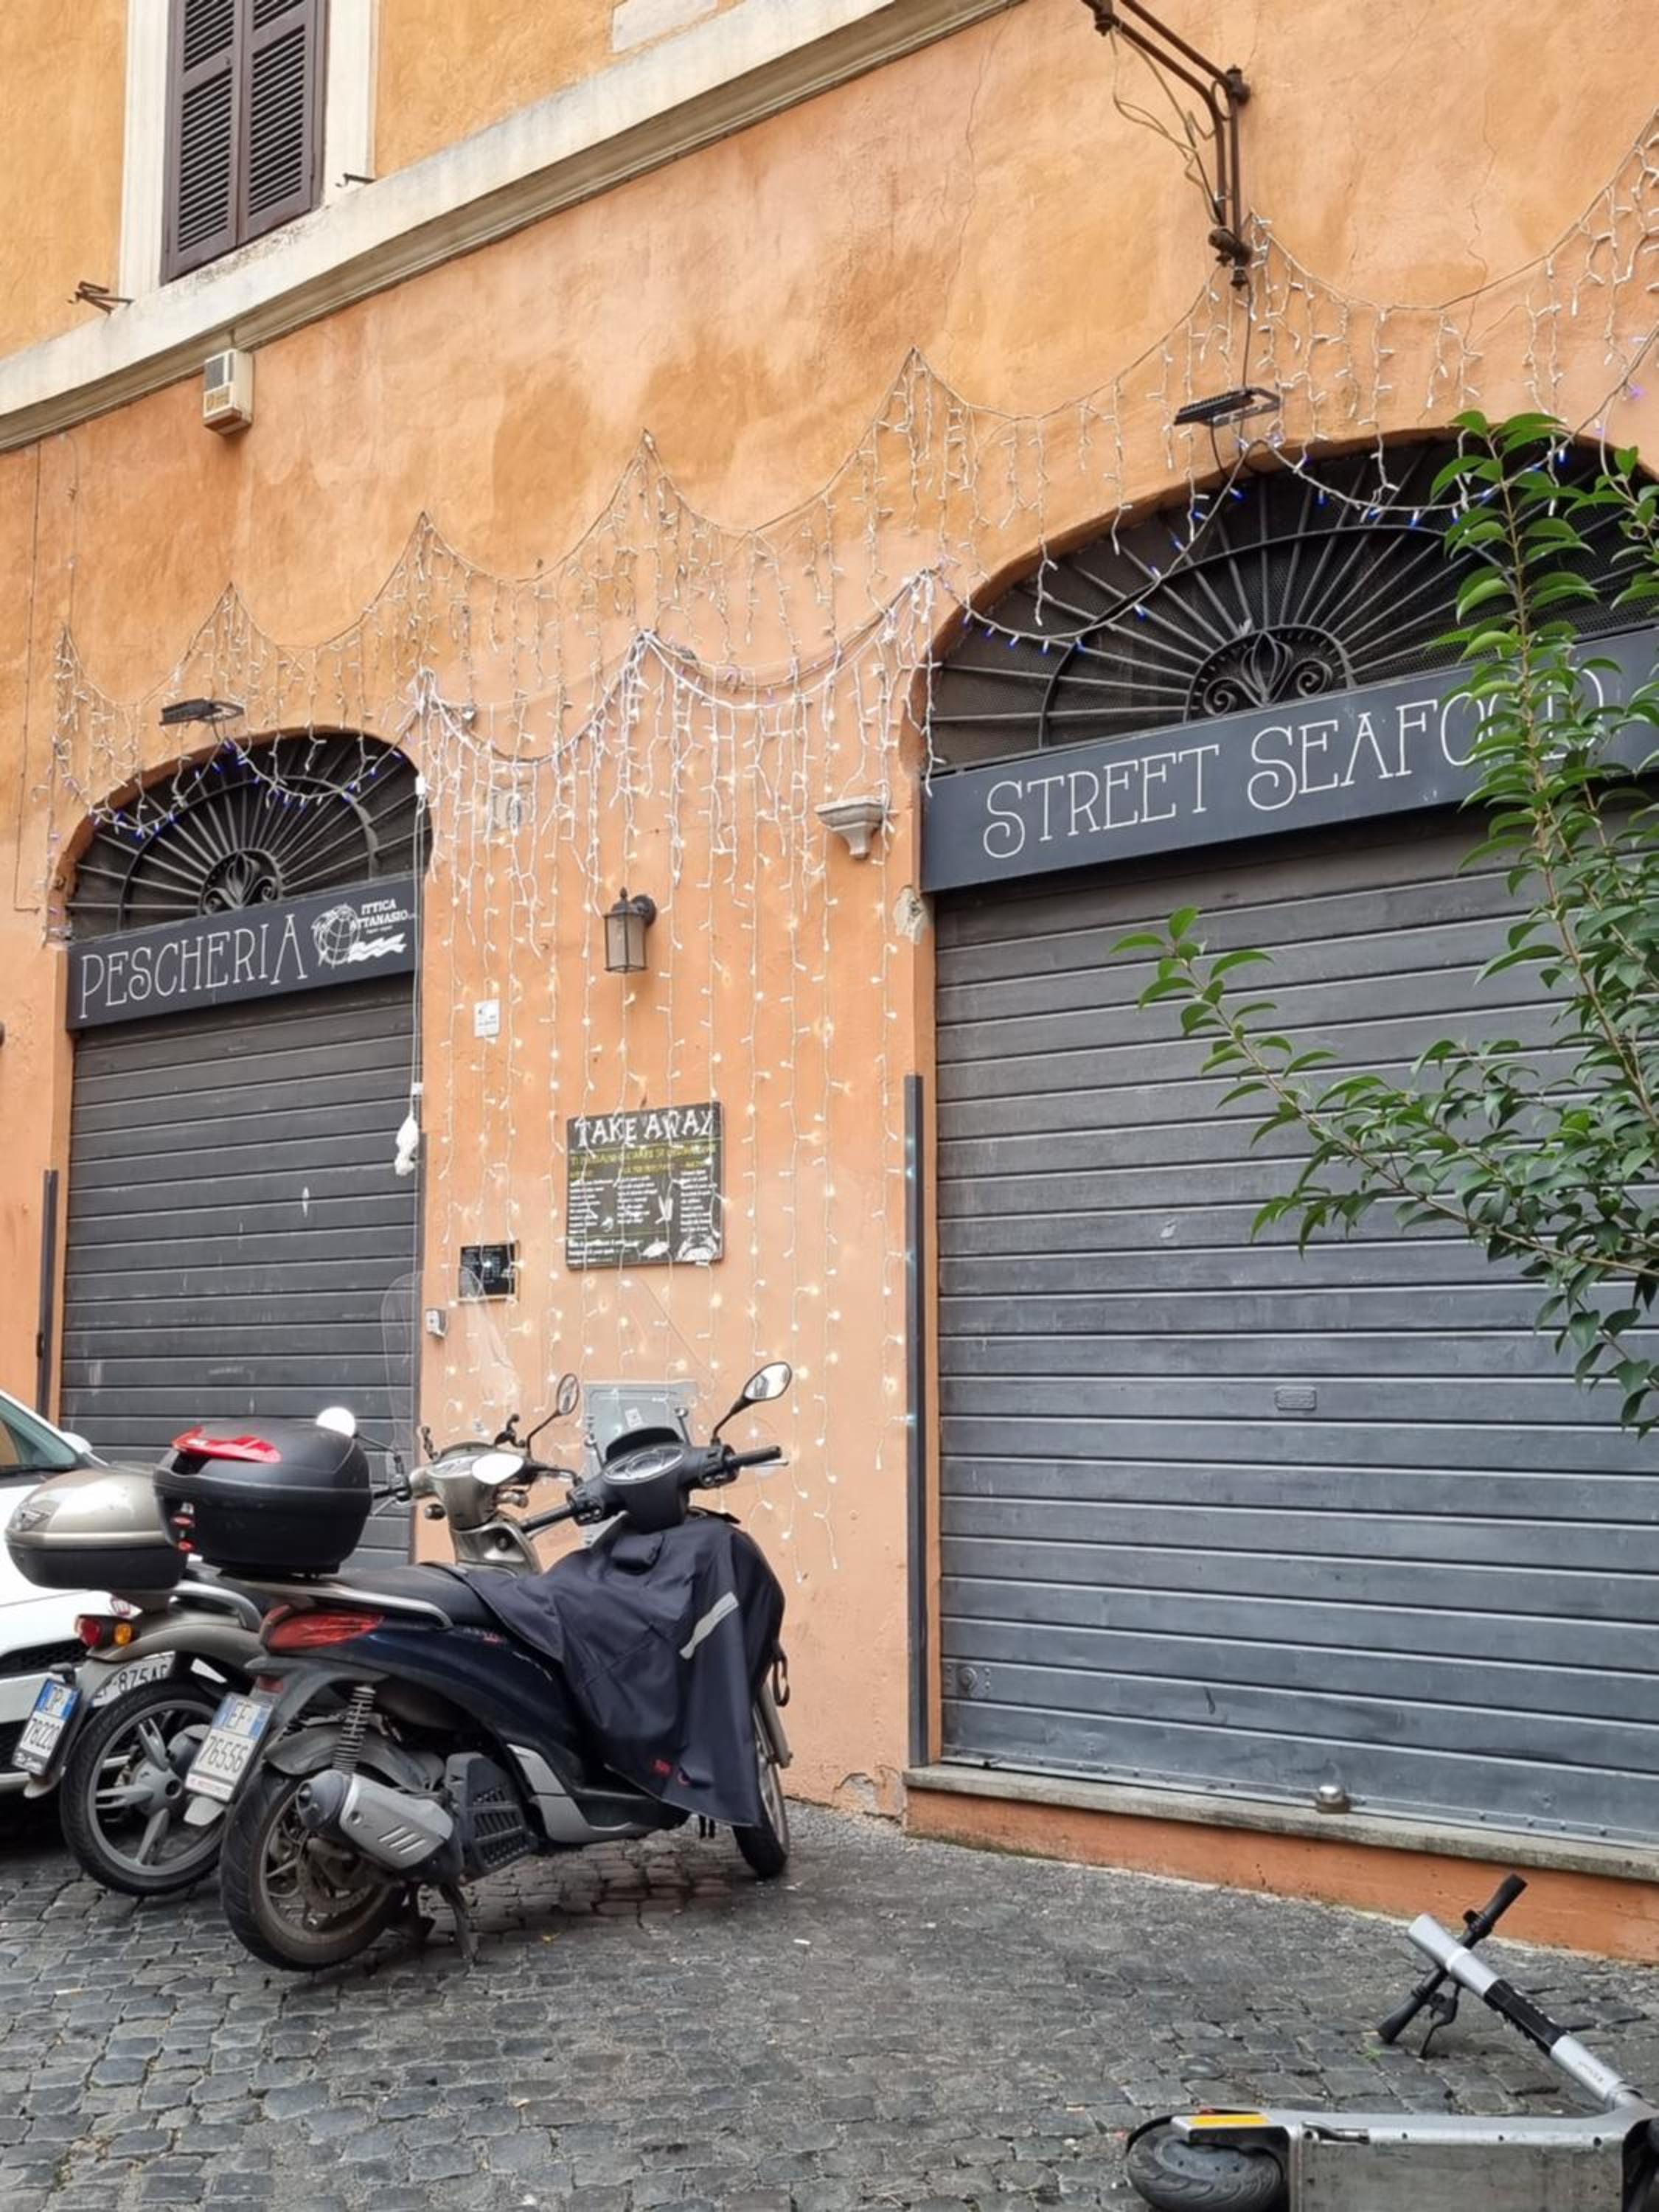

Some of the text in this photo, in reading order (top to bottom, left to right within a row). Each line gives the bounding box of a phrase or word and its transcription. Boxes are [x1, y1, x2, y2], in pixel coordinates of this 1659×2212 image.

[982, 743, 1220, 859] STREET
[361, 898, 397, 915] ITTICA
[79, 913, 308, 1020] PESCHERIA
[574, 1108, 714, 1147] TAKE AWAY
[224, 1700, 252, 1729] EF
[198, 1735, 249, 1774] 76556
